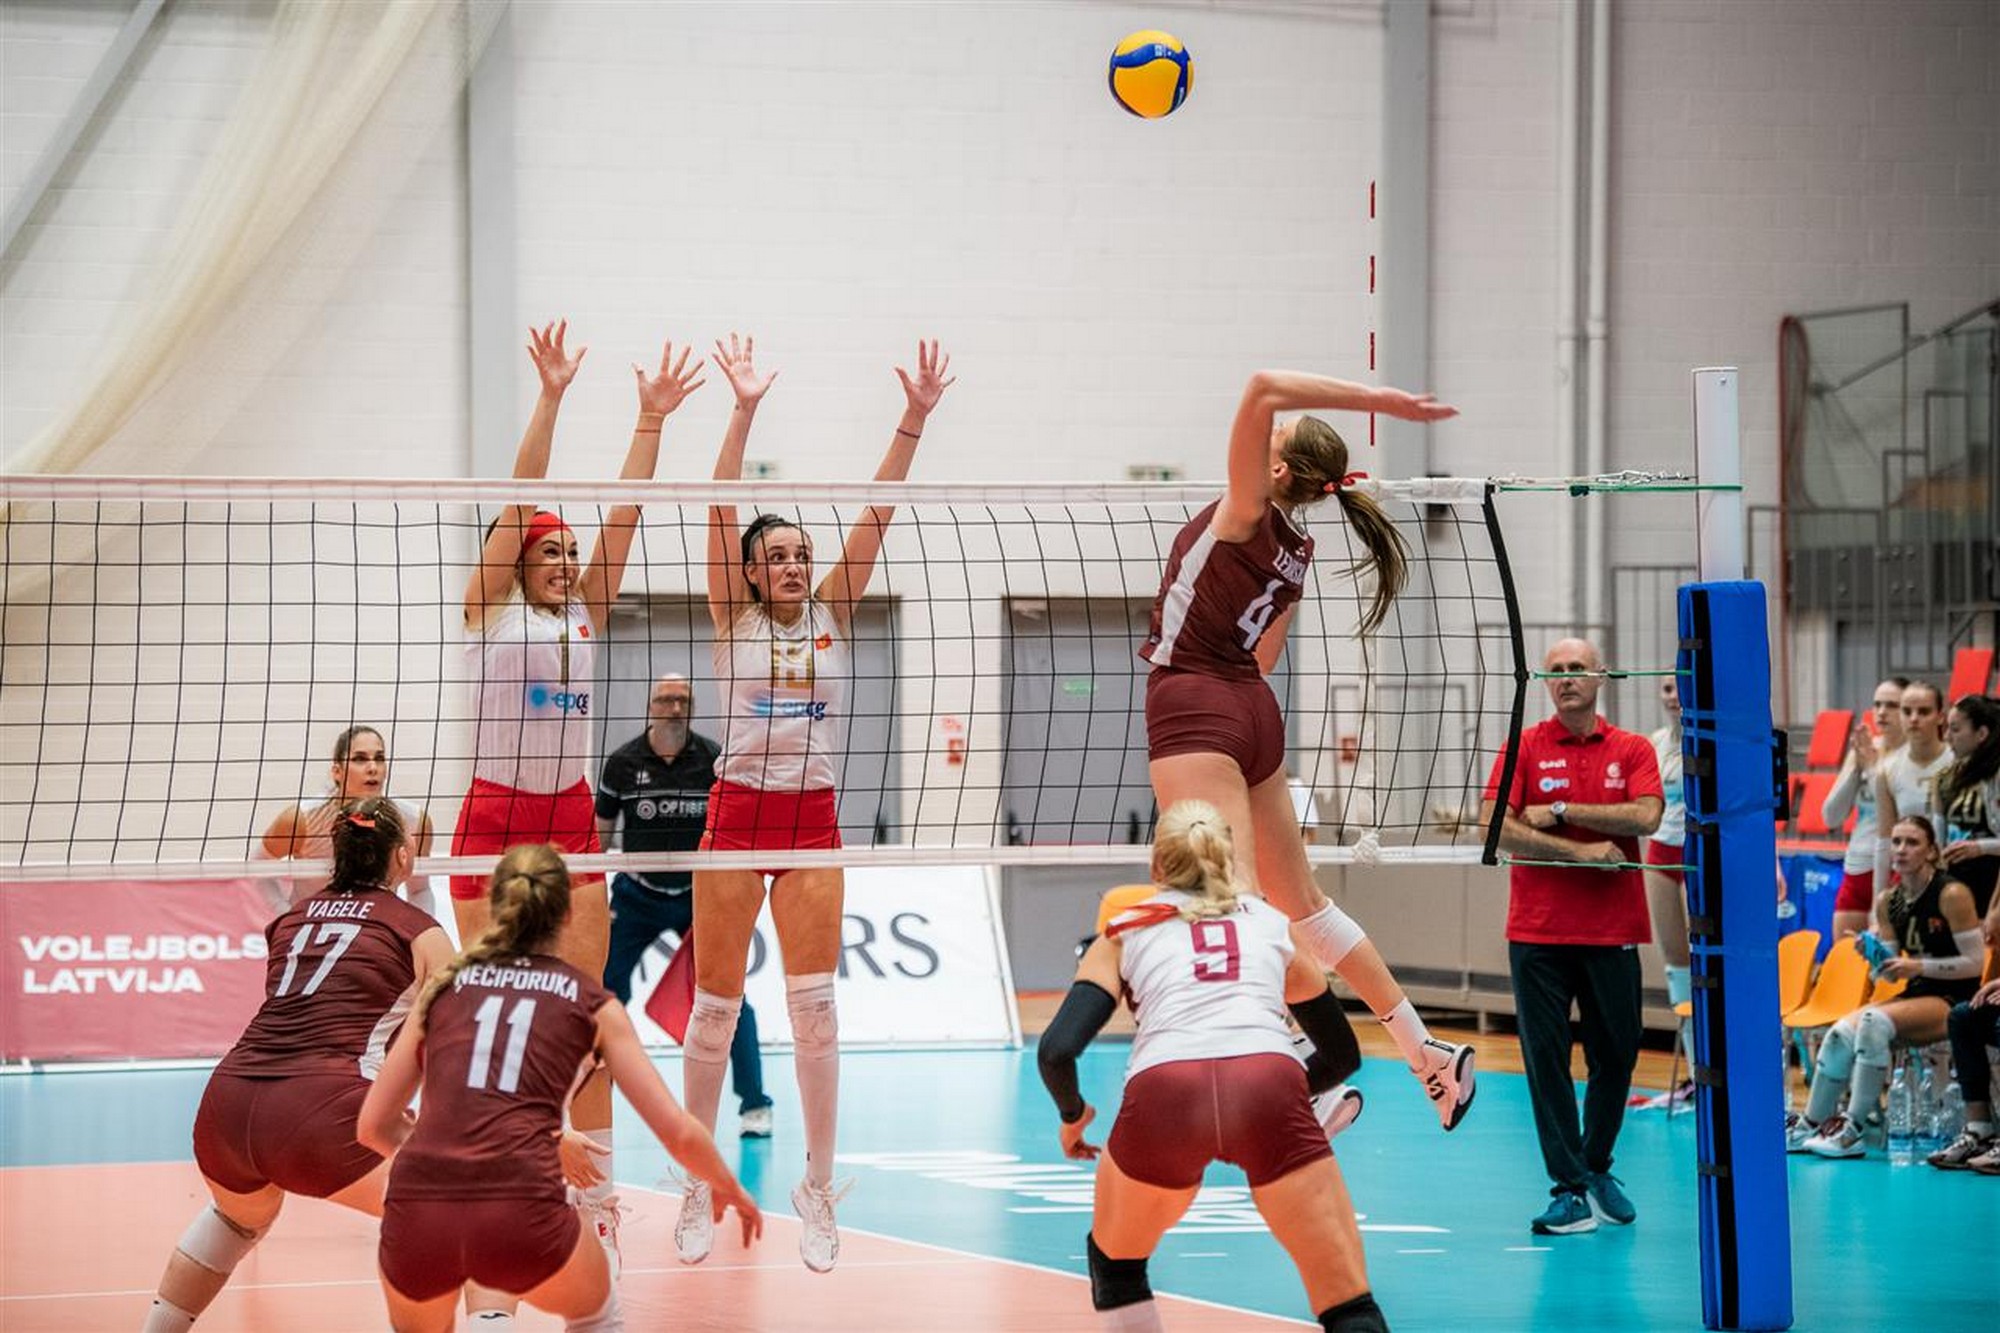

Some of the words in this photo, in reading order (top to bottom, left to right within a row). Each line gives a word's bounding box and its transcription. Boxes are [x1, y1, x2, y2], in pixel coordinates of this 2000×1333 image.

[1237, 578, 1285, 651] 4
[306, 900, 375, 919] VAGELE
[20, 934, 268, 961] VOLEJBOLS
[275, 923, 362, 997] 17
[1190, 919, 1240, 982] 9
[23, 968, 204, 994] LATVIJA
[467, 995, 537, 1093] 11
